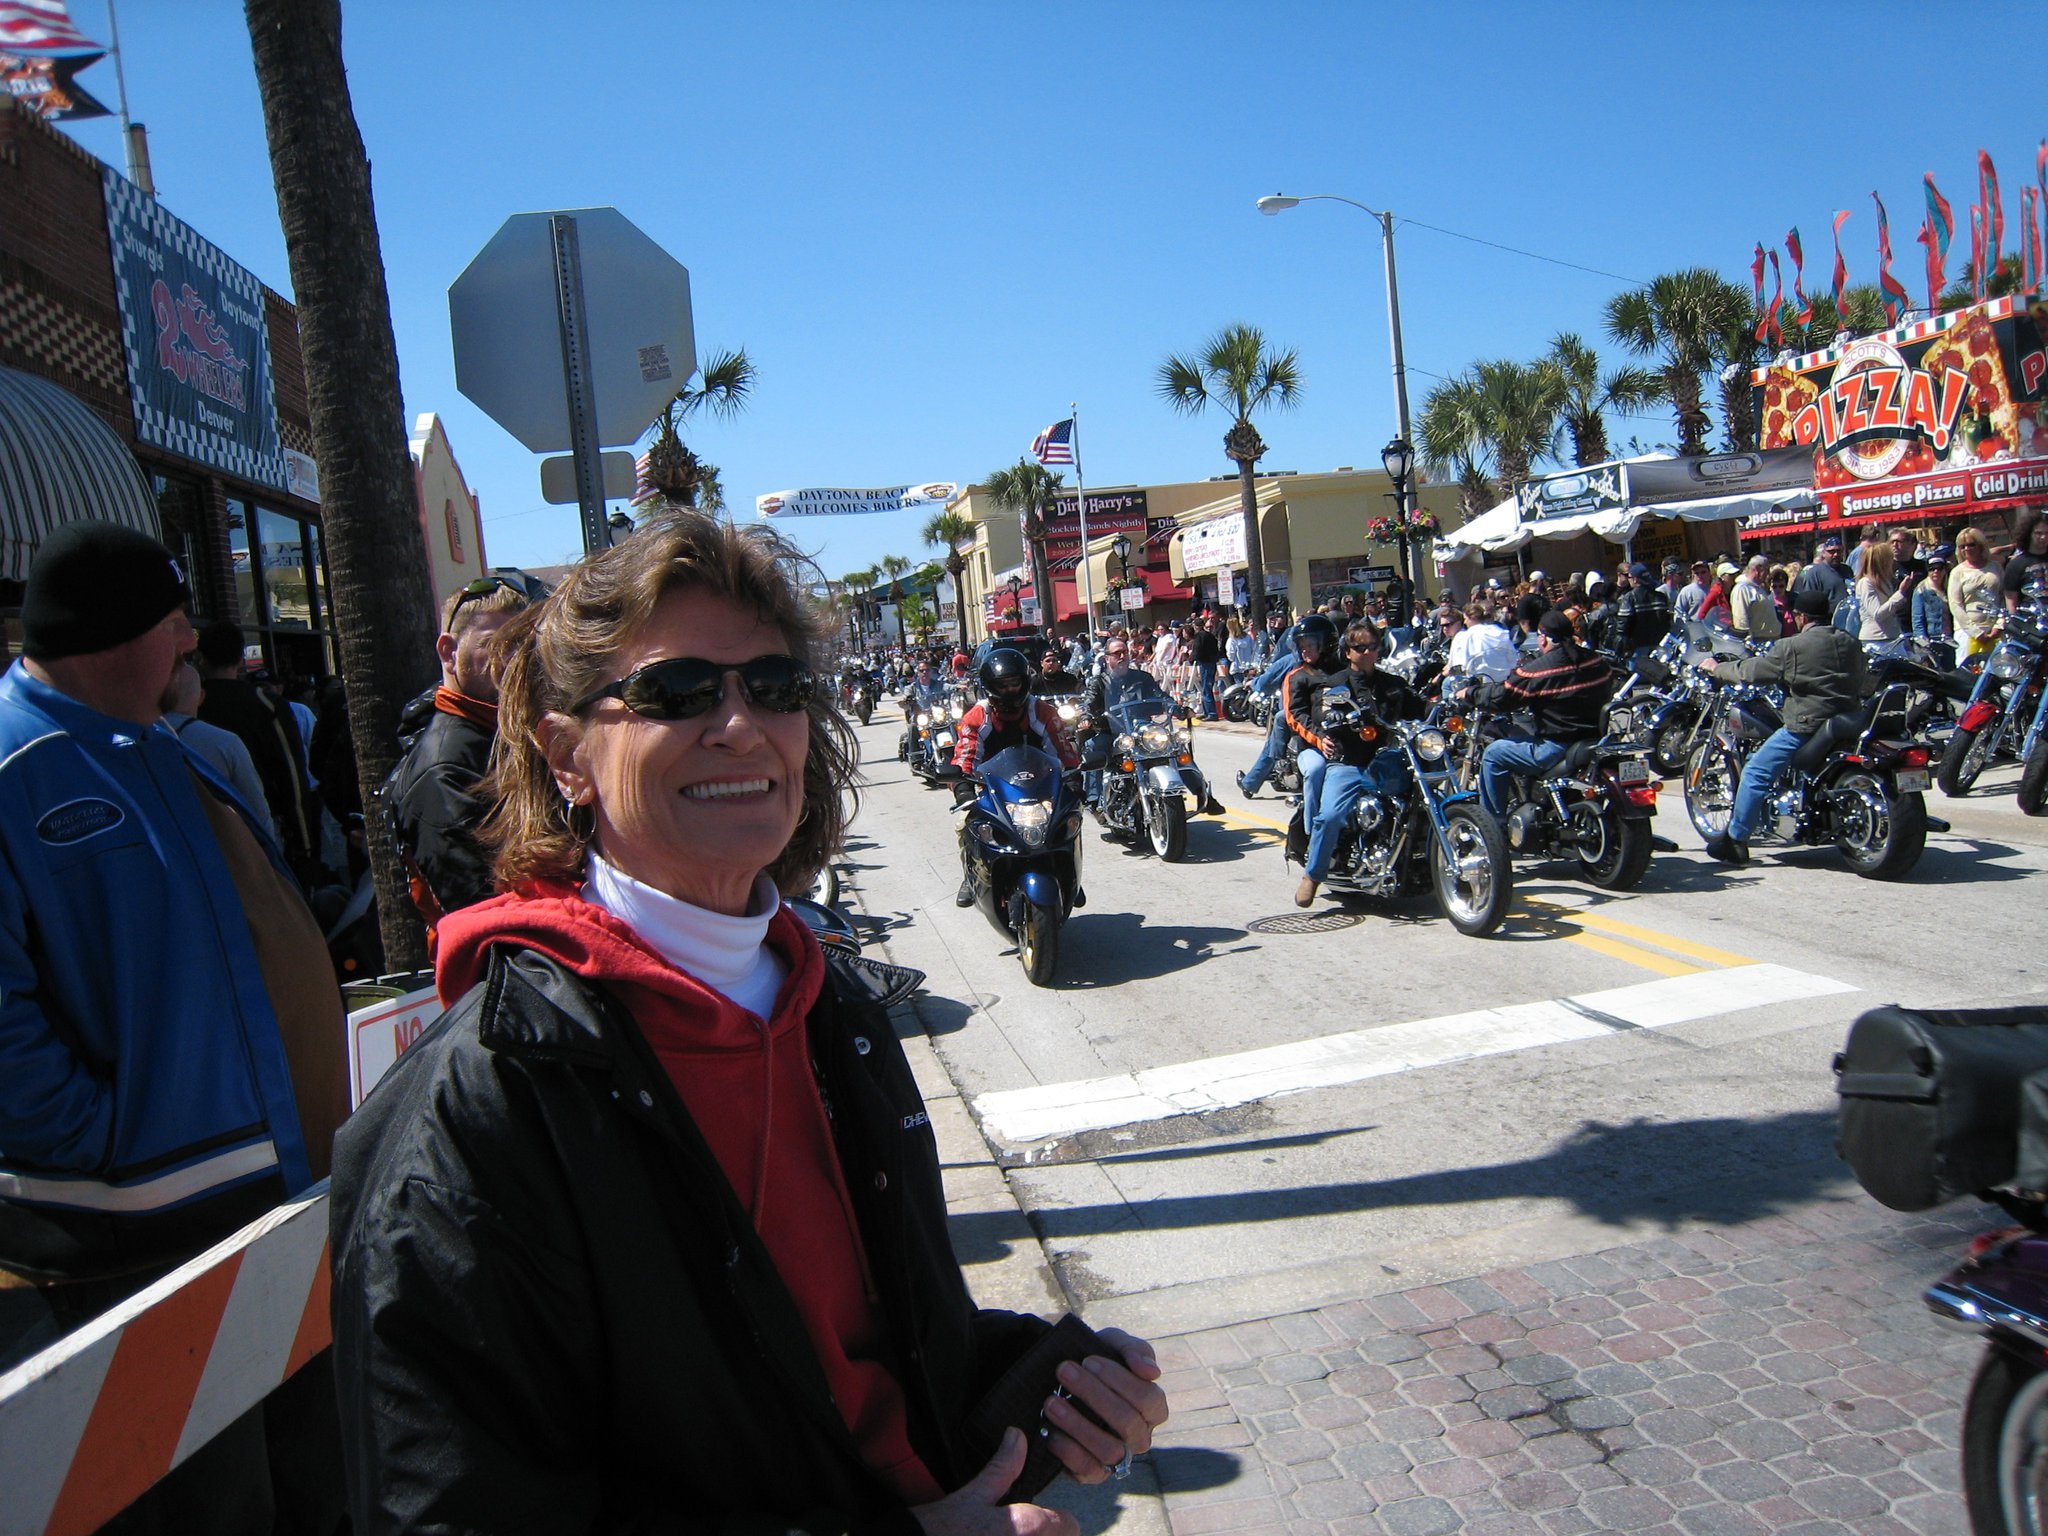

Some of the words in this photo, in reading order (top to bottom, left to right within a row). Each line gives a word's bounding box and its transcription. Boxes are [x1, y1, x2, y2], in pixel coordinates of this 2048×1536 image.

[122, 224, 164, 272] Sturgis
[220, 291, 261, 332] Daytona
[1844, 345, 1887, 369] SCOTT'S
[186, 350, 247, 414] WHEELERS
[197, 400, 235, 434] Denver
[1791, 363, 1971, 452] PIZZA!
[1845, 454, 1876, 475] SINCE
[1879, 446, 1901, 473] 1983
[799, 489, 861, 501] DAYTONA
[866, 487, 909, 500] BEACH
[1842, 484, 1913, 517] Sausage
[1914, 482, 1965, 507] Pizza
[1974, 473, 2005, 497] Cold
[791, 502, 869, 515] WELCOMES
[873, 497, 921, 512] BIKERS
[1089, 495, 1133, 514] Harry's
[1112, 518, 1143, 529] Nightly
[393, 1015, 424, 1060] NO
